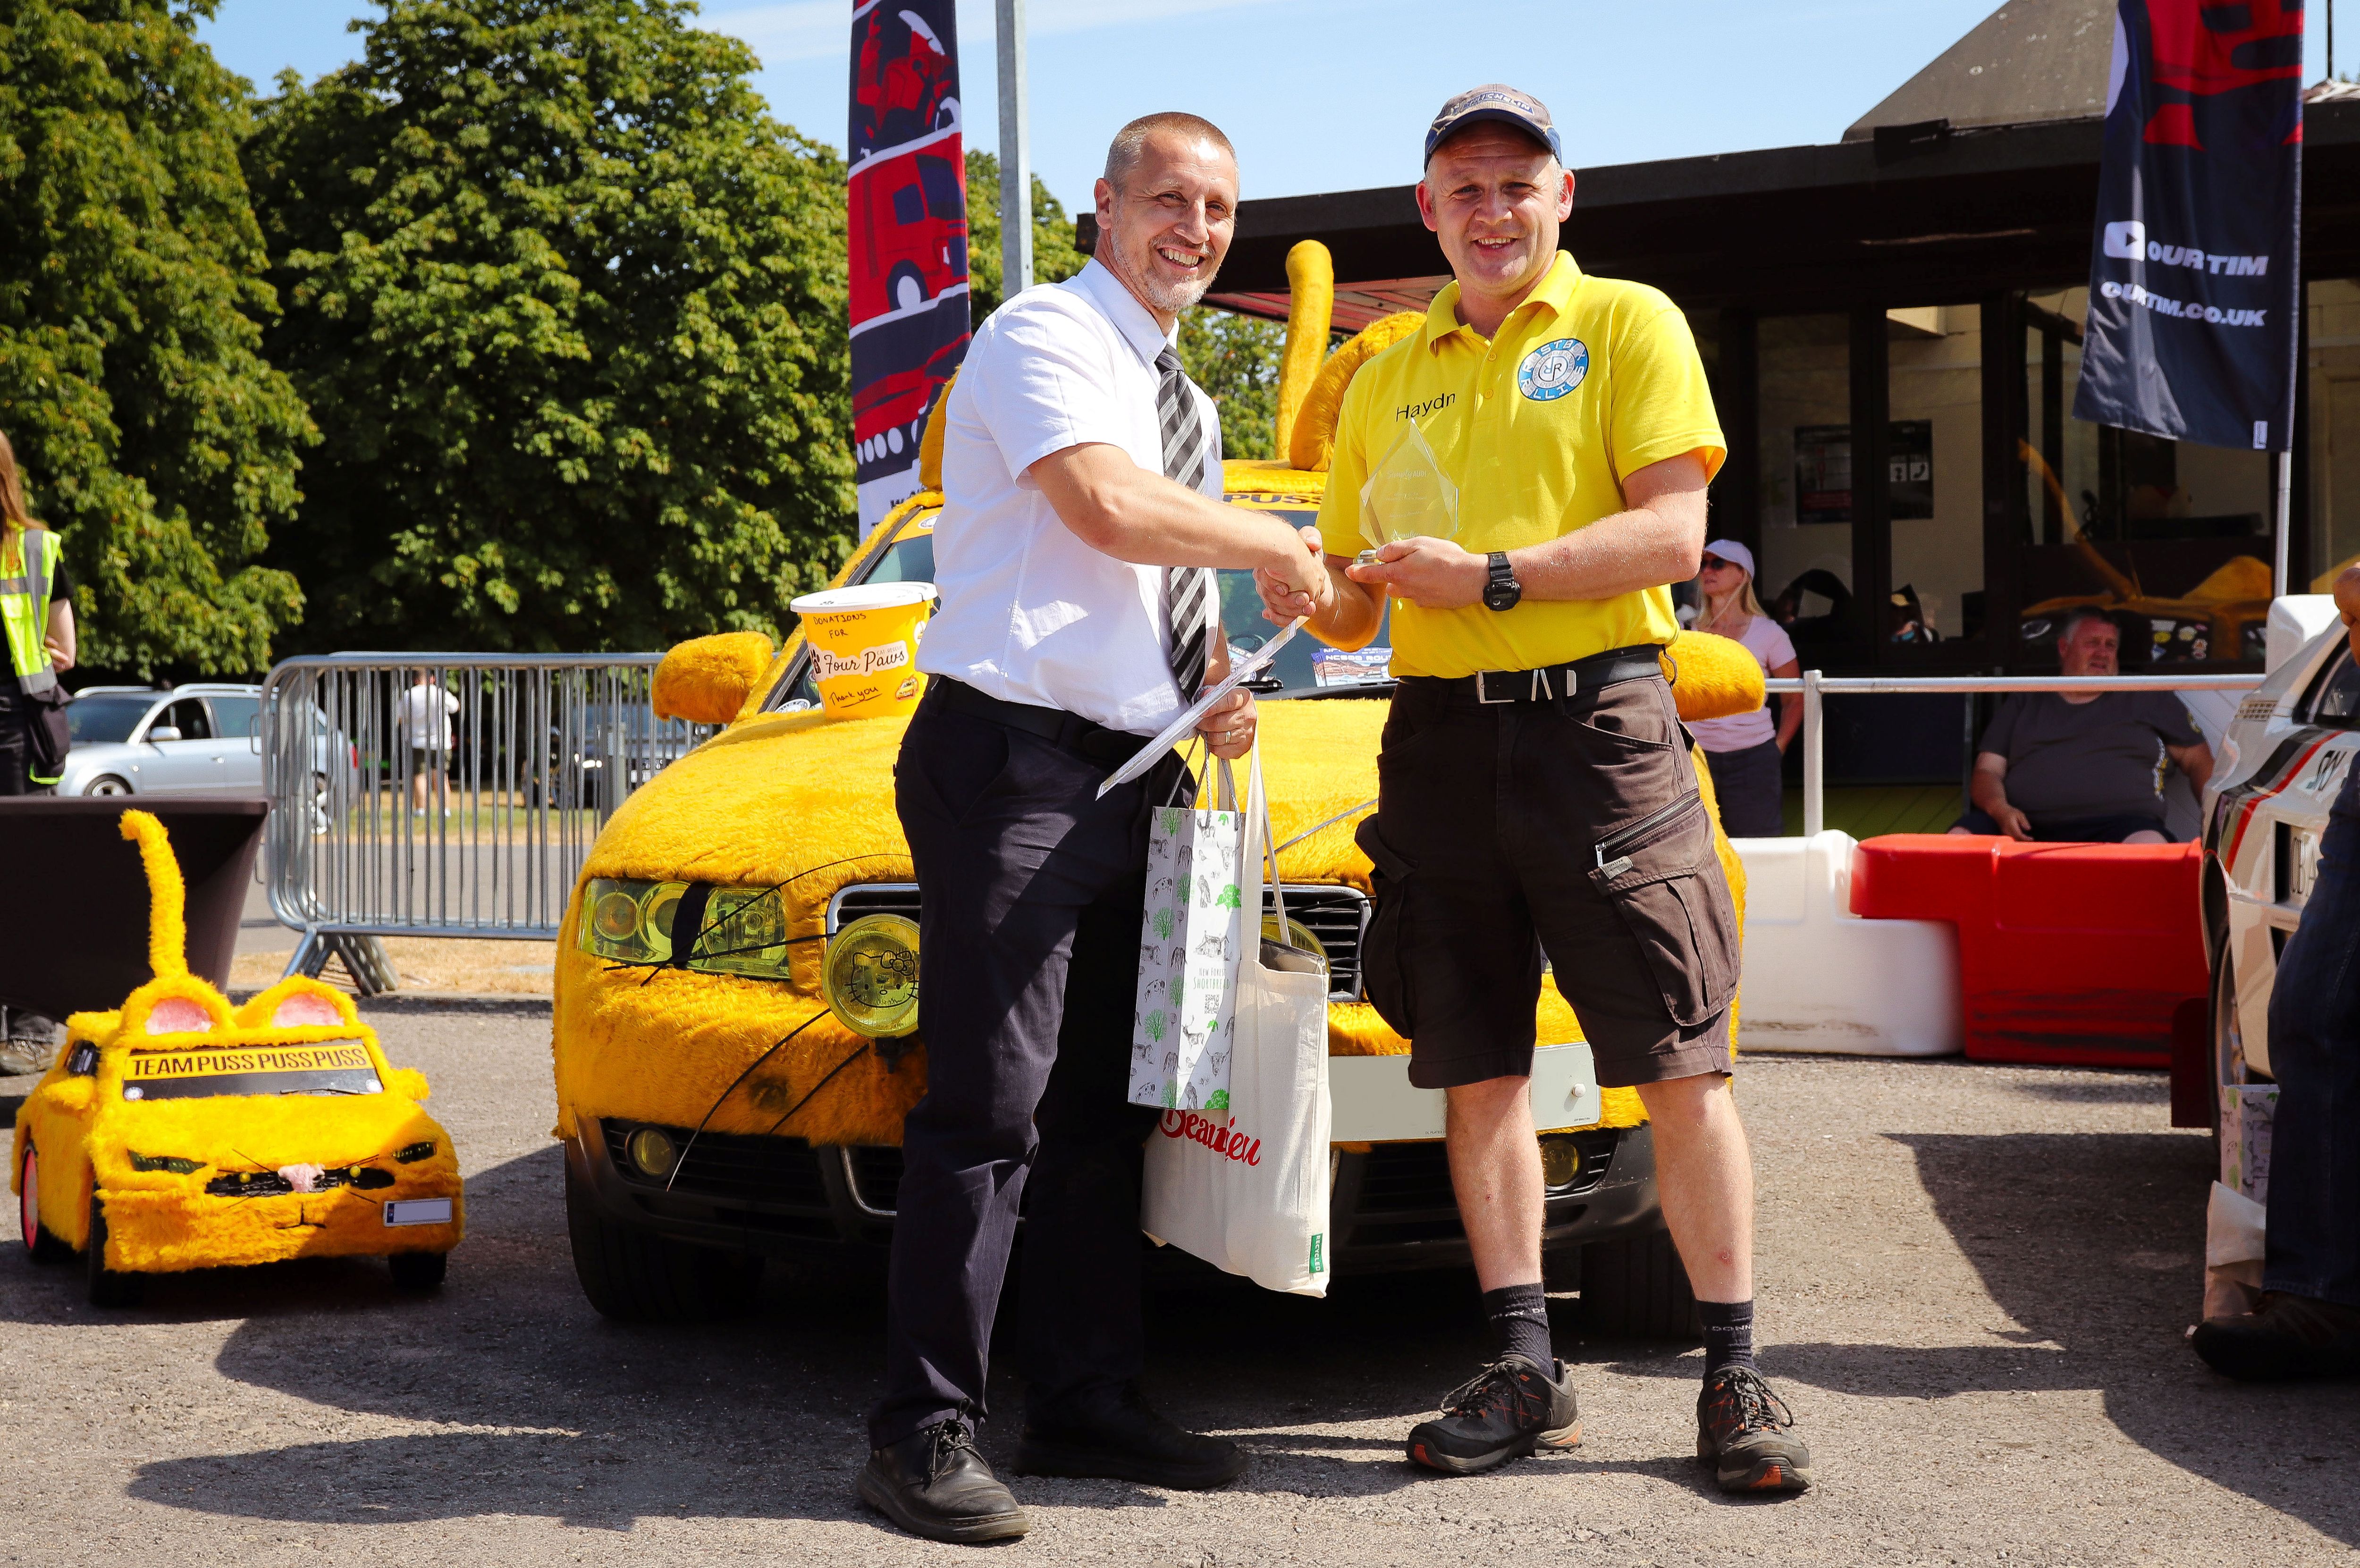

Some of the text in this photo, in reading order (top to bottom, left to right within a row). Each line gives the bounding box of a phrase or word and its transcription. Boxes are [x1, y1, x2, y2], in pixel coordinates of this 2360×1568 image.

[2100, 281, 2269, 327] OURTIM.CO.UK
[1396, 392, 1455, 422] Haydn
[813, 613, 866, 625] DONATIONS
[828, 629, 848, 639] FOR
[824, 650, 904, 674] Four Paws
[829, 686, 879, 706] Thank you
[134, 1048, 368, 1076] TEAM PUSS PUSS PUSS
